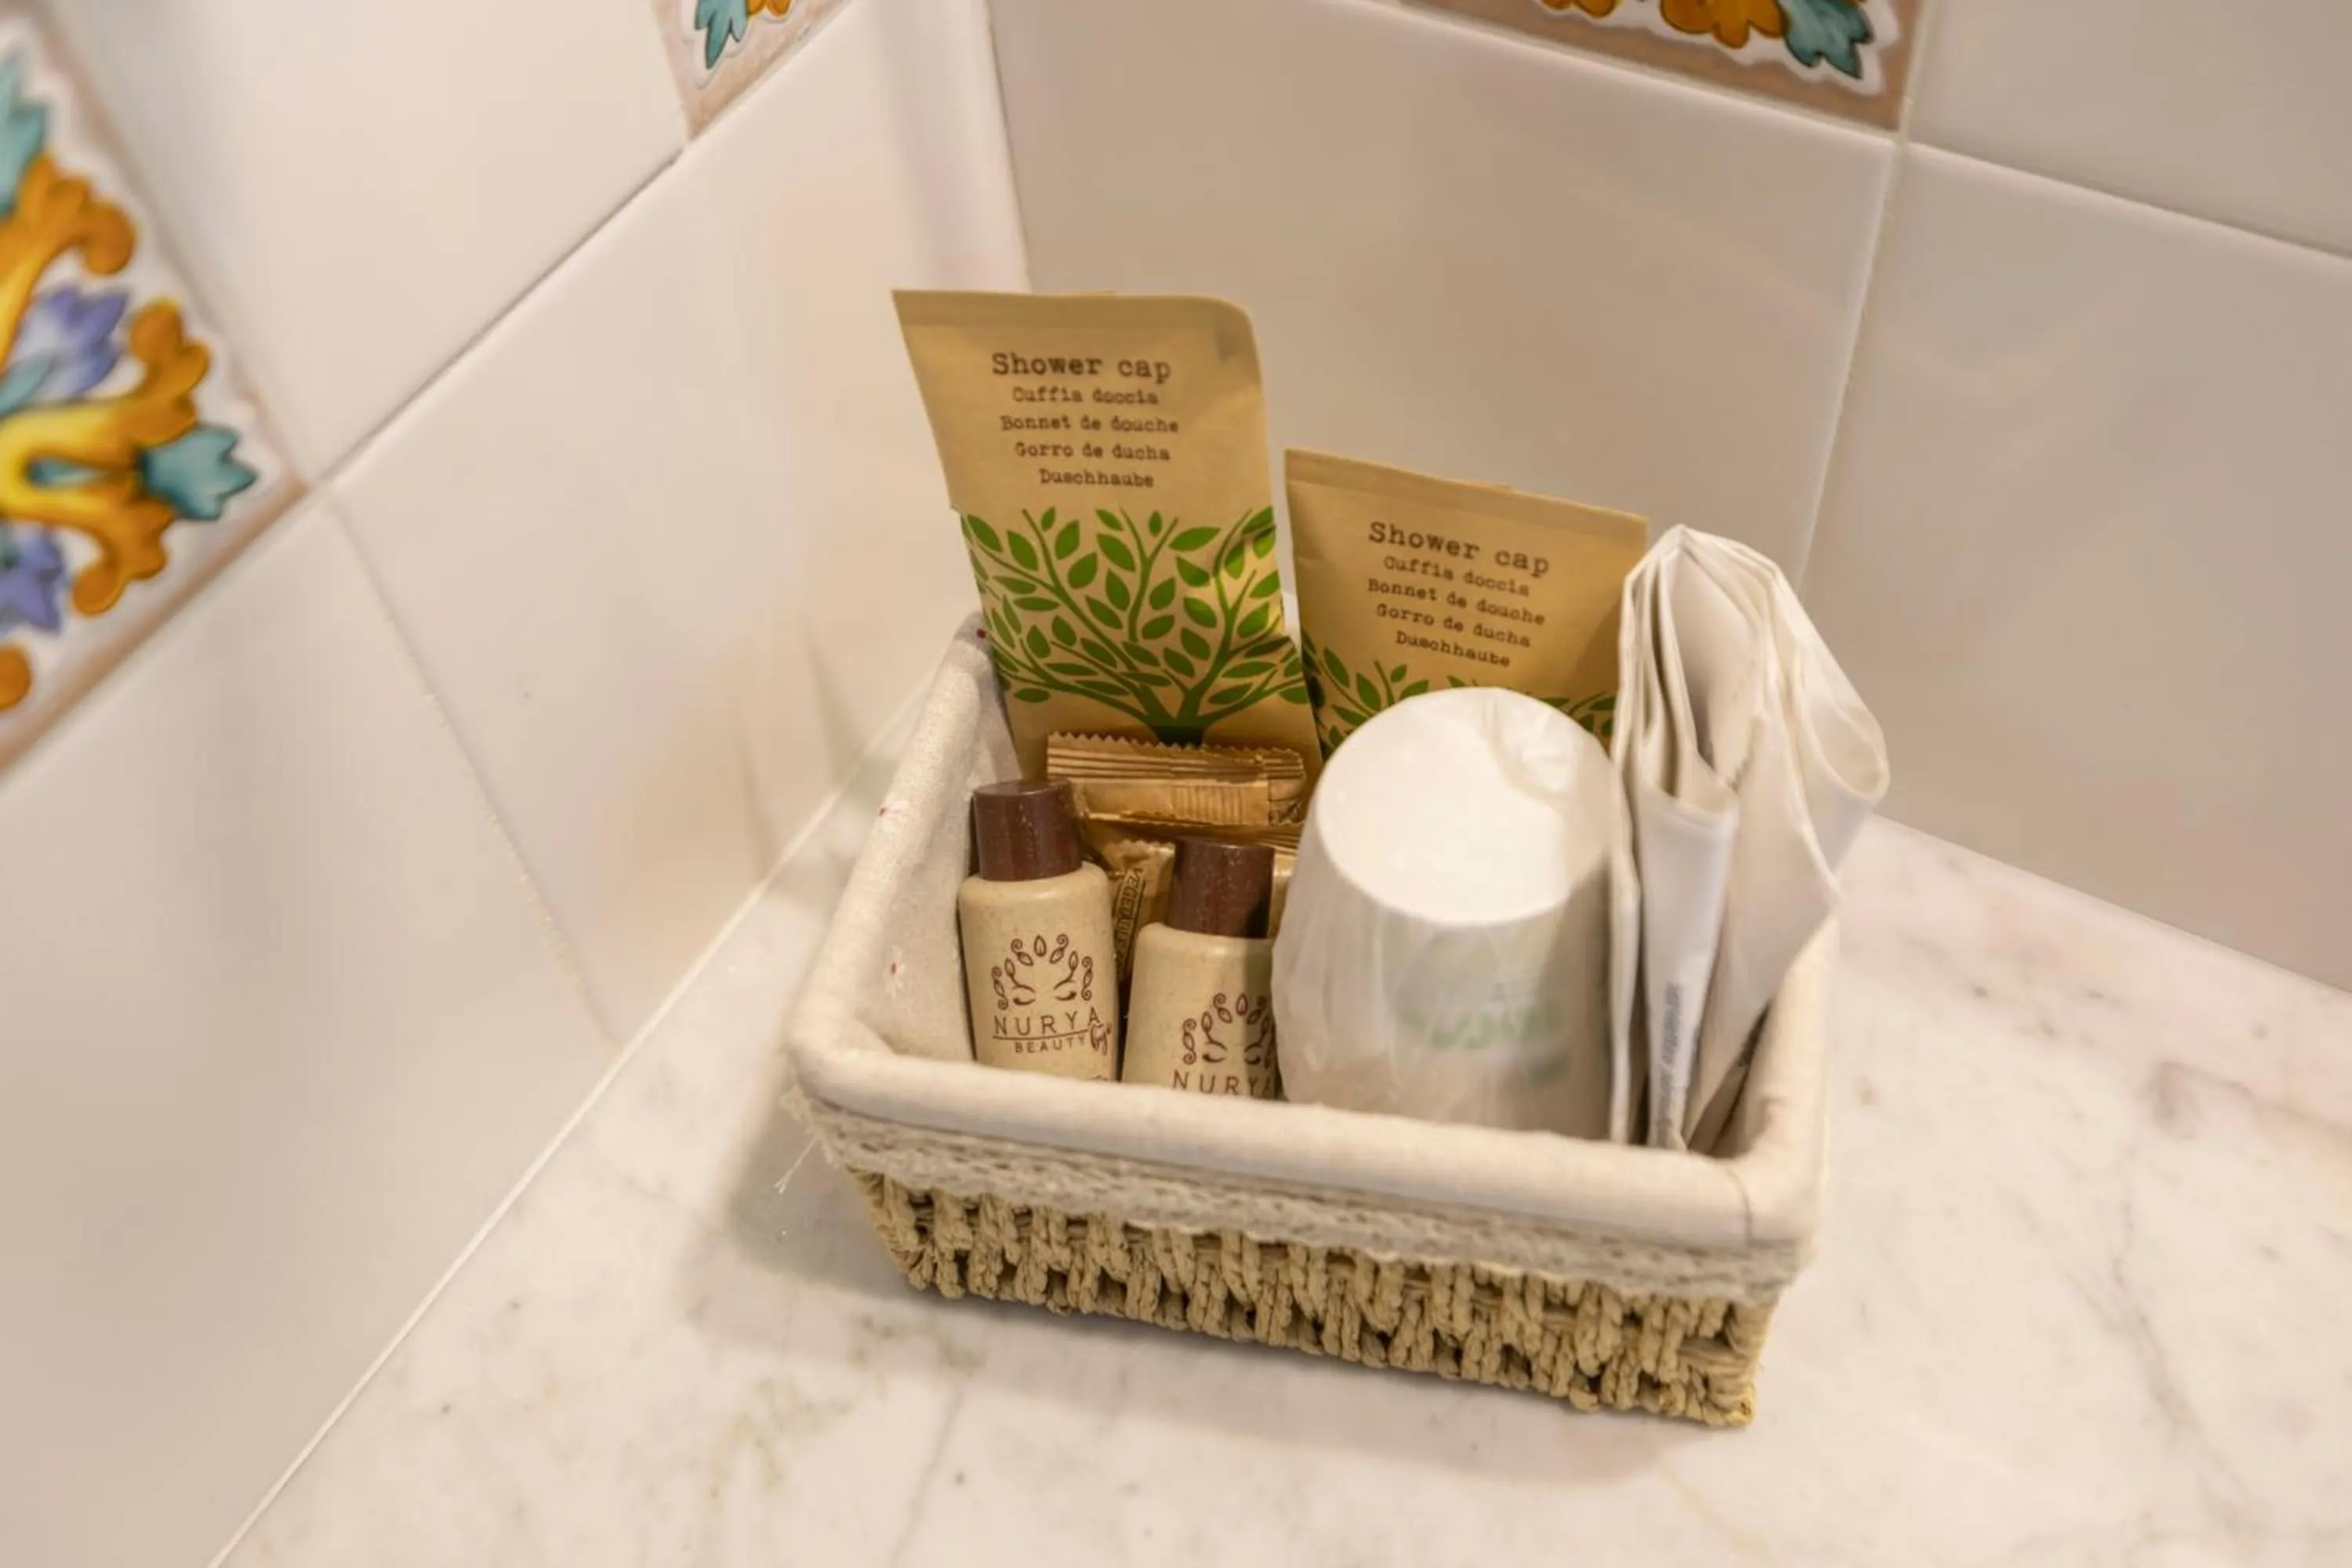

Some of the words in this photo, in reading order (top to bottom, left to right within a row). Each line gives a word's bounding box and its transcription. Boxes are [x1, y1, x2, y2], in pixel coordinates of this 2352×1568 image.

[992, 352, 1103, 376] Shower
[1118, 358, 1171, 384] cap
[1012, 387, 1083, 404] Cuffia
[1092, 388, 1158, 405] doccia
[1001, 416, 1071, 432] Bonnet
[1080, 414, 1102, 431] de
[1110, 416, 1178, 434] douche
[1014, 442, 1074, 458] Gorro
[1082, 442, 1104, 459] de
[1112, 444, 1170, 461] ducha
[1040, 469, 1154, 488] Duschhaube
[1368, 521, 1480, 561] Shower
[1495, 550, 1550, 577] cap
[1384, 555, 1454, 579] Cuffia
[1464, 571, 1530, 597] doccia
[1367, 579, 1437, 602] Bonnet
[1447, 590, 1468, 609] de
[1476, 597, 1546, 626] douche
[1377, 604, 1435, 626] Gorro
[1443, 615, 1464, 633] de
[1474, 622, 1530, 648] ducha
[1396, 630, 1510, 667] Duschhaube
[993, 1007, 1102, 1036] NURYA
[1014, 1036, 1087, 1053] BEAUTY
